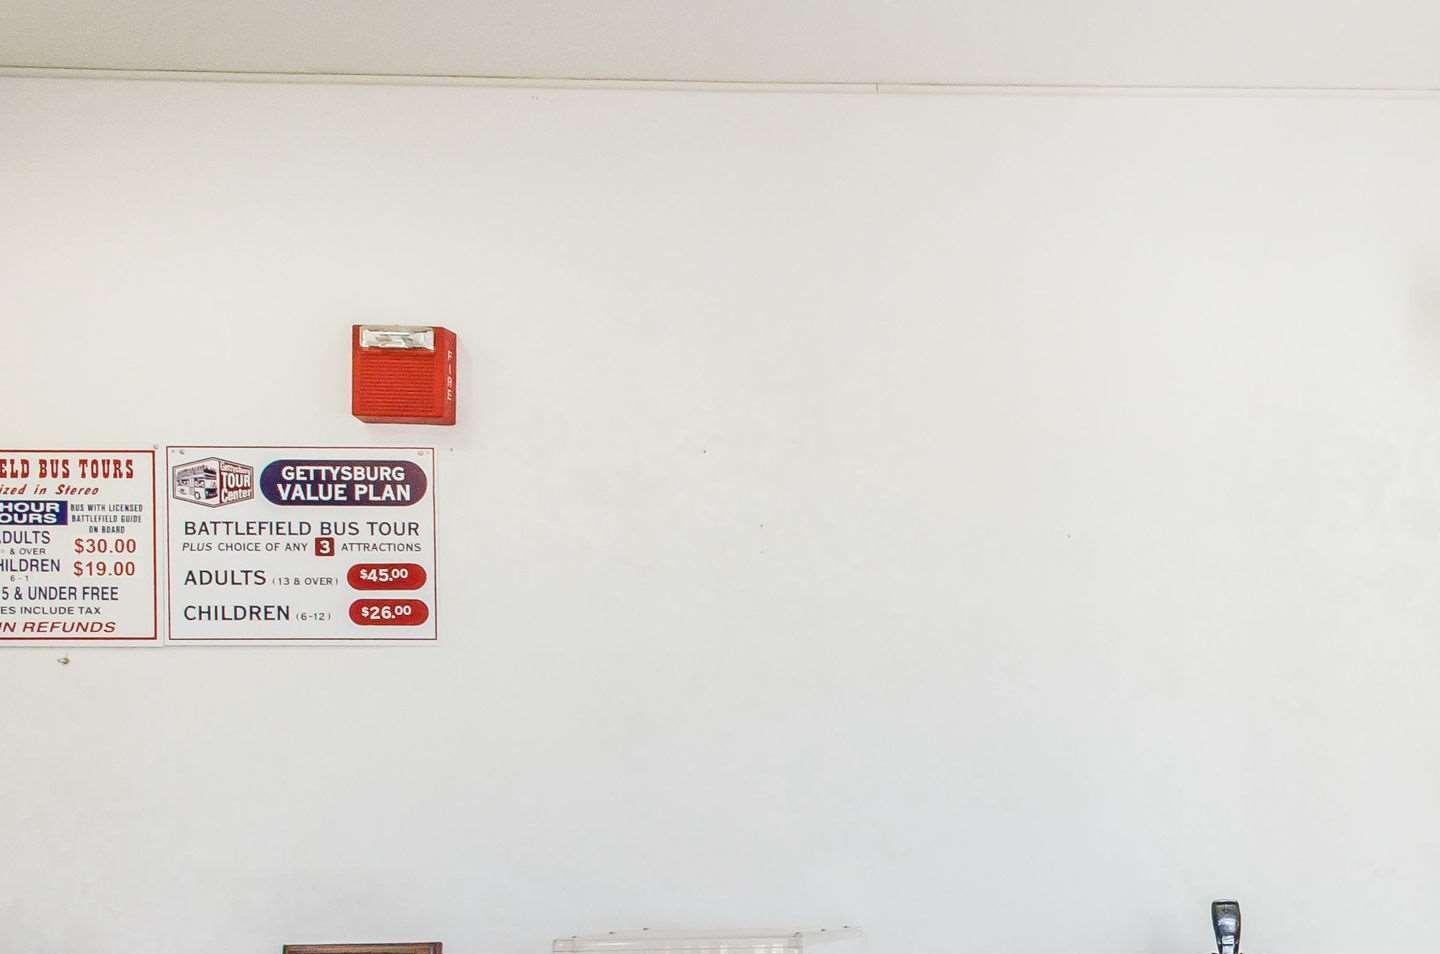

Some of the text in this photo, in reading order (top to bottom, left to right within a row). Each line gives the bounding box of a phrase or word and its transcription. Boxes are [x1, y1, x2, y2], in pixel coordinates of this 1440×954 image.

[38, 459, 70, 479] BUS
[78, 459, 134, 479] TOURS
[281, 465, 405, 482] GETTYSBURG
[221, 471, 250, 490] TOUR
[33, 483, 48, 496] in
[56, 483, 100, 496] Stereo
[276, 484, 411, 501] VALUE PLAN
[70, 503, 144, 513] BUS WITH LICENSED
[71, 514, 142, 524] BATTLEFIELD GUIDE
[88, 525, 126, 534] ON BOARD
[184, 521, 419, 536] BATTLEFIELD BUS TOUR
[0, 530, 137, 555] DULTS $30.00
[182, 541, 422, 555] PLUS CHOICE OF ANY 3 ATTRACTIONS
[19, 547, 46, 556] OVER
[73, 560, 136, 577] $19.00
[184, 570, 267, 586] ADULTS
[359, 568, 409, 583] $45.00
[14, 586, 23, 601] &
[28, 586, 77, 601] UNDER
[82, 586, 119, 601] FREE
[20, 606, 74, 615] INCLUDE
[78, 606, 101, 615] TAX
[183, 605, 412, 622] CHILDREN (6-12) $26.00
[22, 621, 117, 633] REFUNDS
